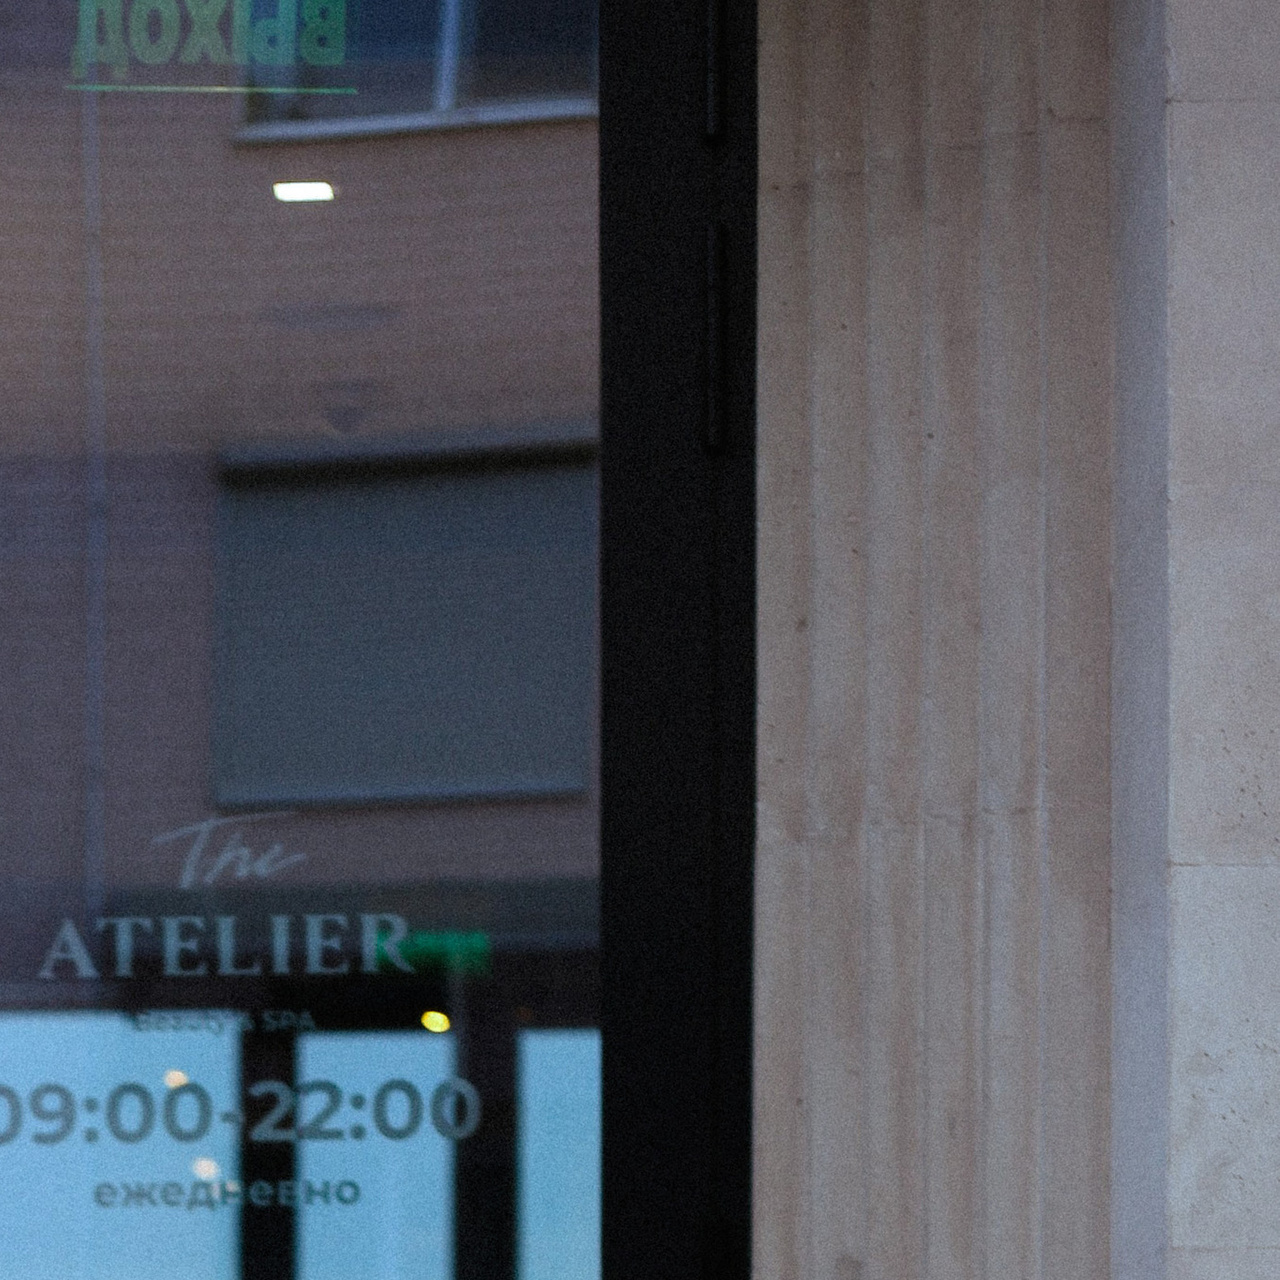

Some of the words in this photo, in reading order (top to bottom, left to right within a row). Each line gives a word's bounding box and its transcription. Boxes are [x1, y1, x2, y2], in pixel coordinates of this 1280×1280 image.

[152, 811, 308, 891] The
[39, 912, 416, 979] ATELIER
[94, 1179, 362, 1211] ежедневно
